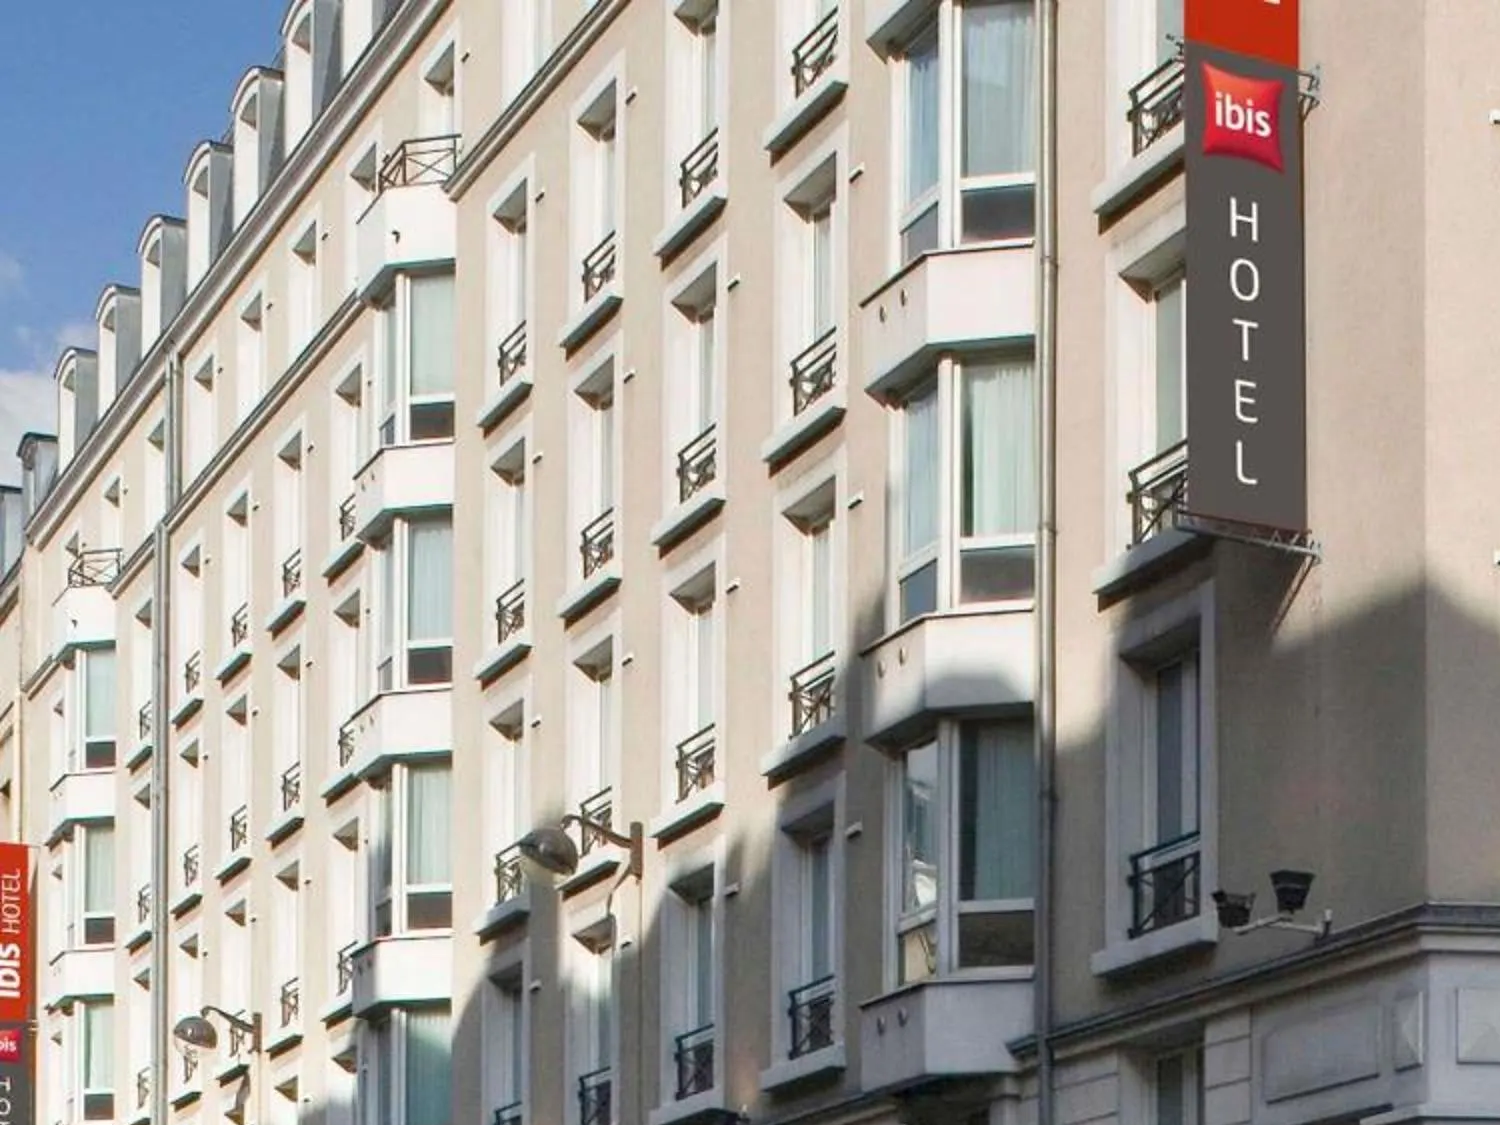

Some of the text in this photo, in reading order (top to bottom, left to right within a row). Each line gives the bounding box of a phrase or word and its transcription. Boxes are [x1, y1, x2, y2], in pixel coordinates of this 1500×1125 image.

[1215, 91, 1271, 137] ibis
[1229, 197, 1260, 486] HOTEL
[1, 867, 20, 934] HOTEL
